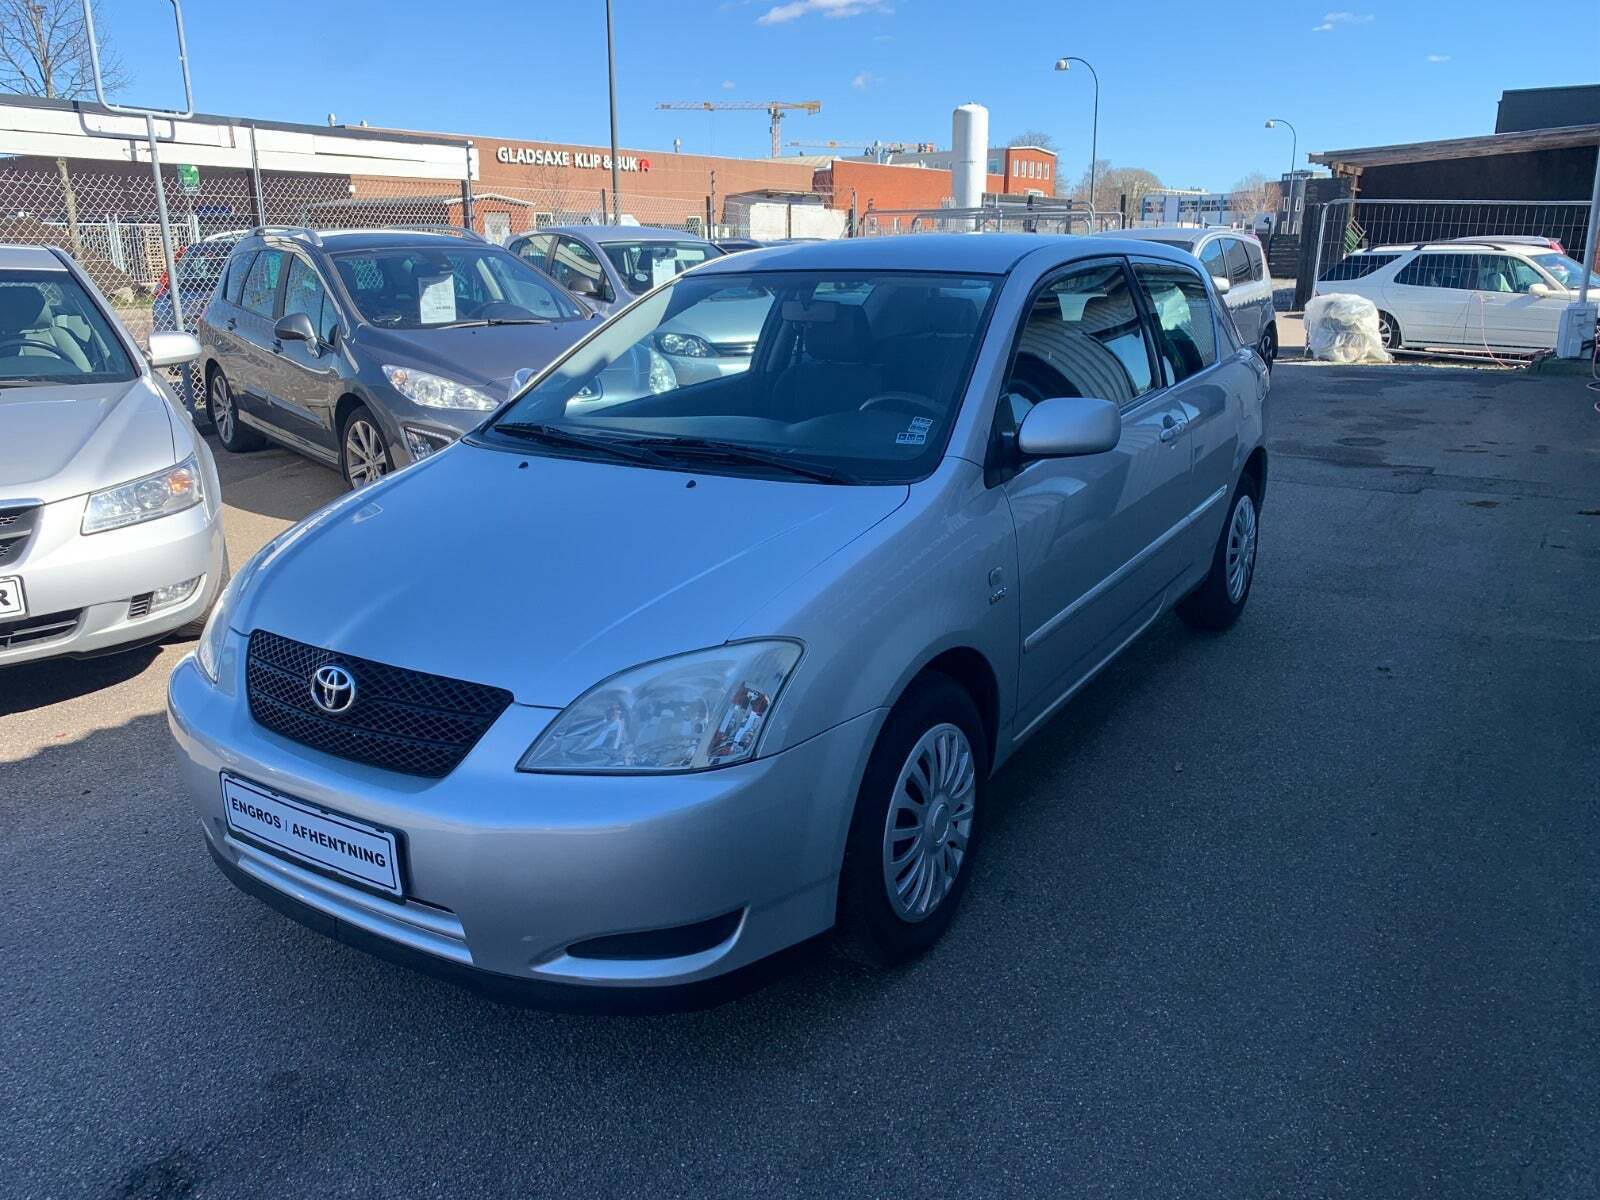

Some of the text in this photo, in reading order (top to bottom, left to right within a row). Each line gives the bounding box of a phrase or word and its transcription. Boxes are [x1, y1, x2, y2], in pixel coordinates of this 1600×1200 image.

[497, 146, 570, 166] GLADSAXE
[574, 152, 601, 168] KLIP
[603, 155, 613, 169] &
[231, 797, 386, 867] ENGROS AFHENTNING
